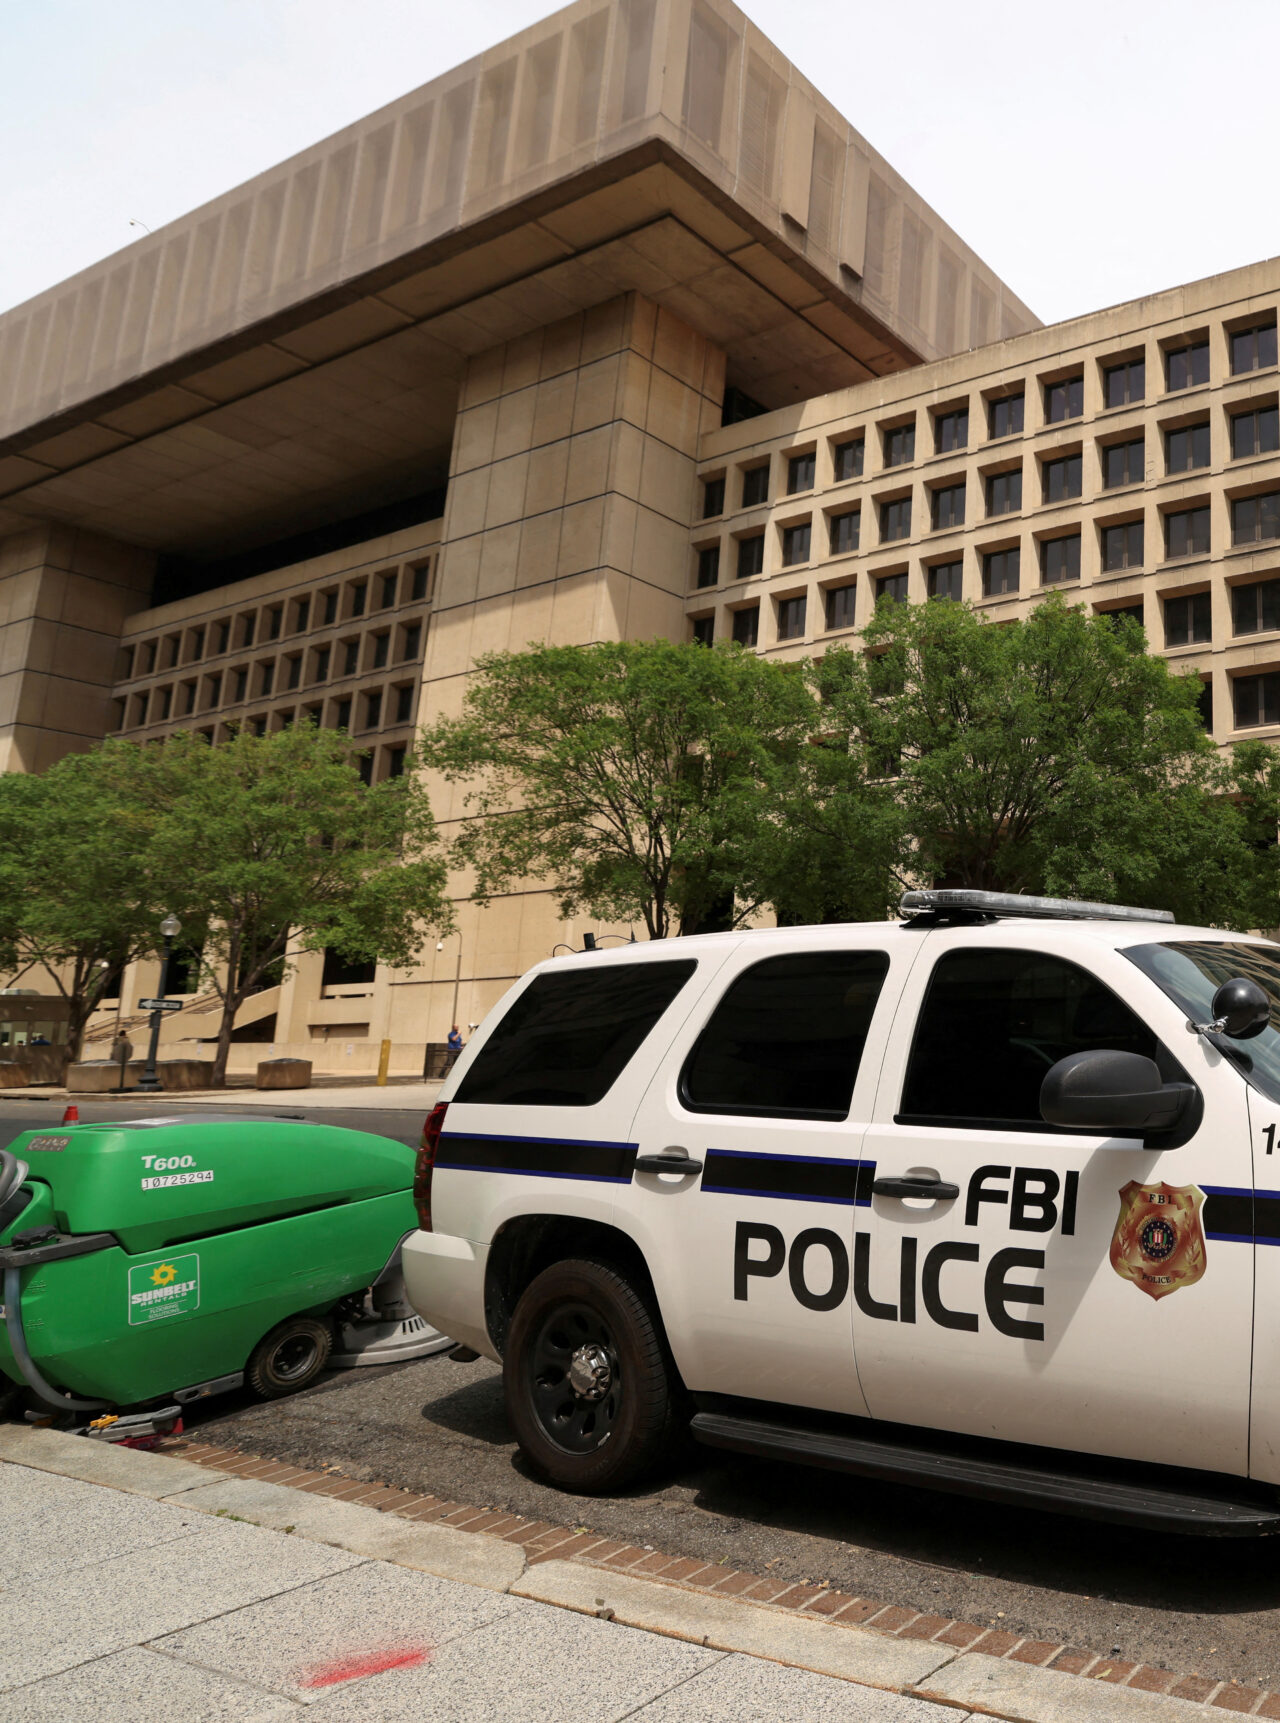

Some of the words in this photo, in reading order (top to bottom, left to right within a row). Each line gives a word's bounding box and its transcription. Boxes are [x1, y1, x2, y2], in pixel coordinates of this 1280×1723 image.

[143, 1171, 212, 1189] 10725294
[965, 1165, 1080, 1236] FBI
[1148, 1193, 1172, 1205] FBI
[734, 1221, 1046, 1342] POLICE
[1141, 1274, 1172, 1284] POLICE
[131, 1280, 196, 1305] SUNBELT
[140, 1292, 187, 1307] RENTALS
